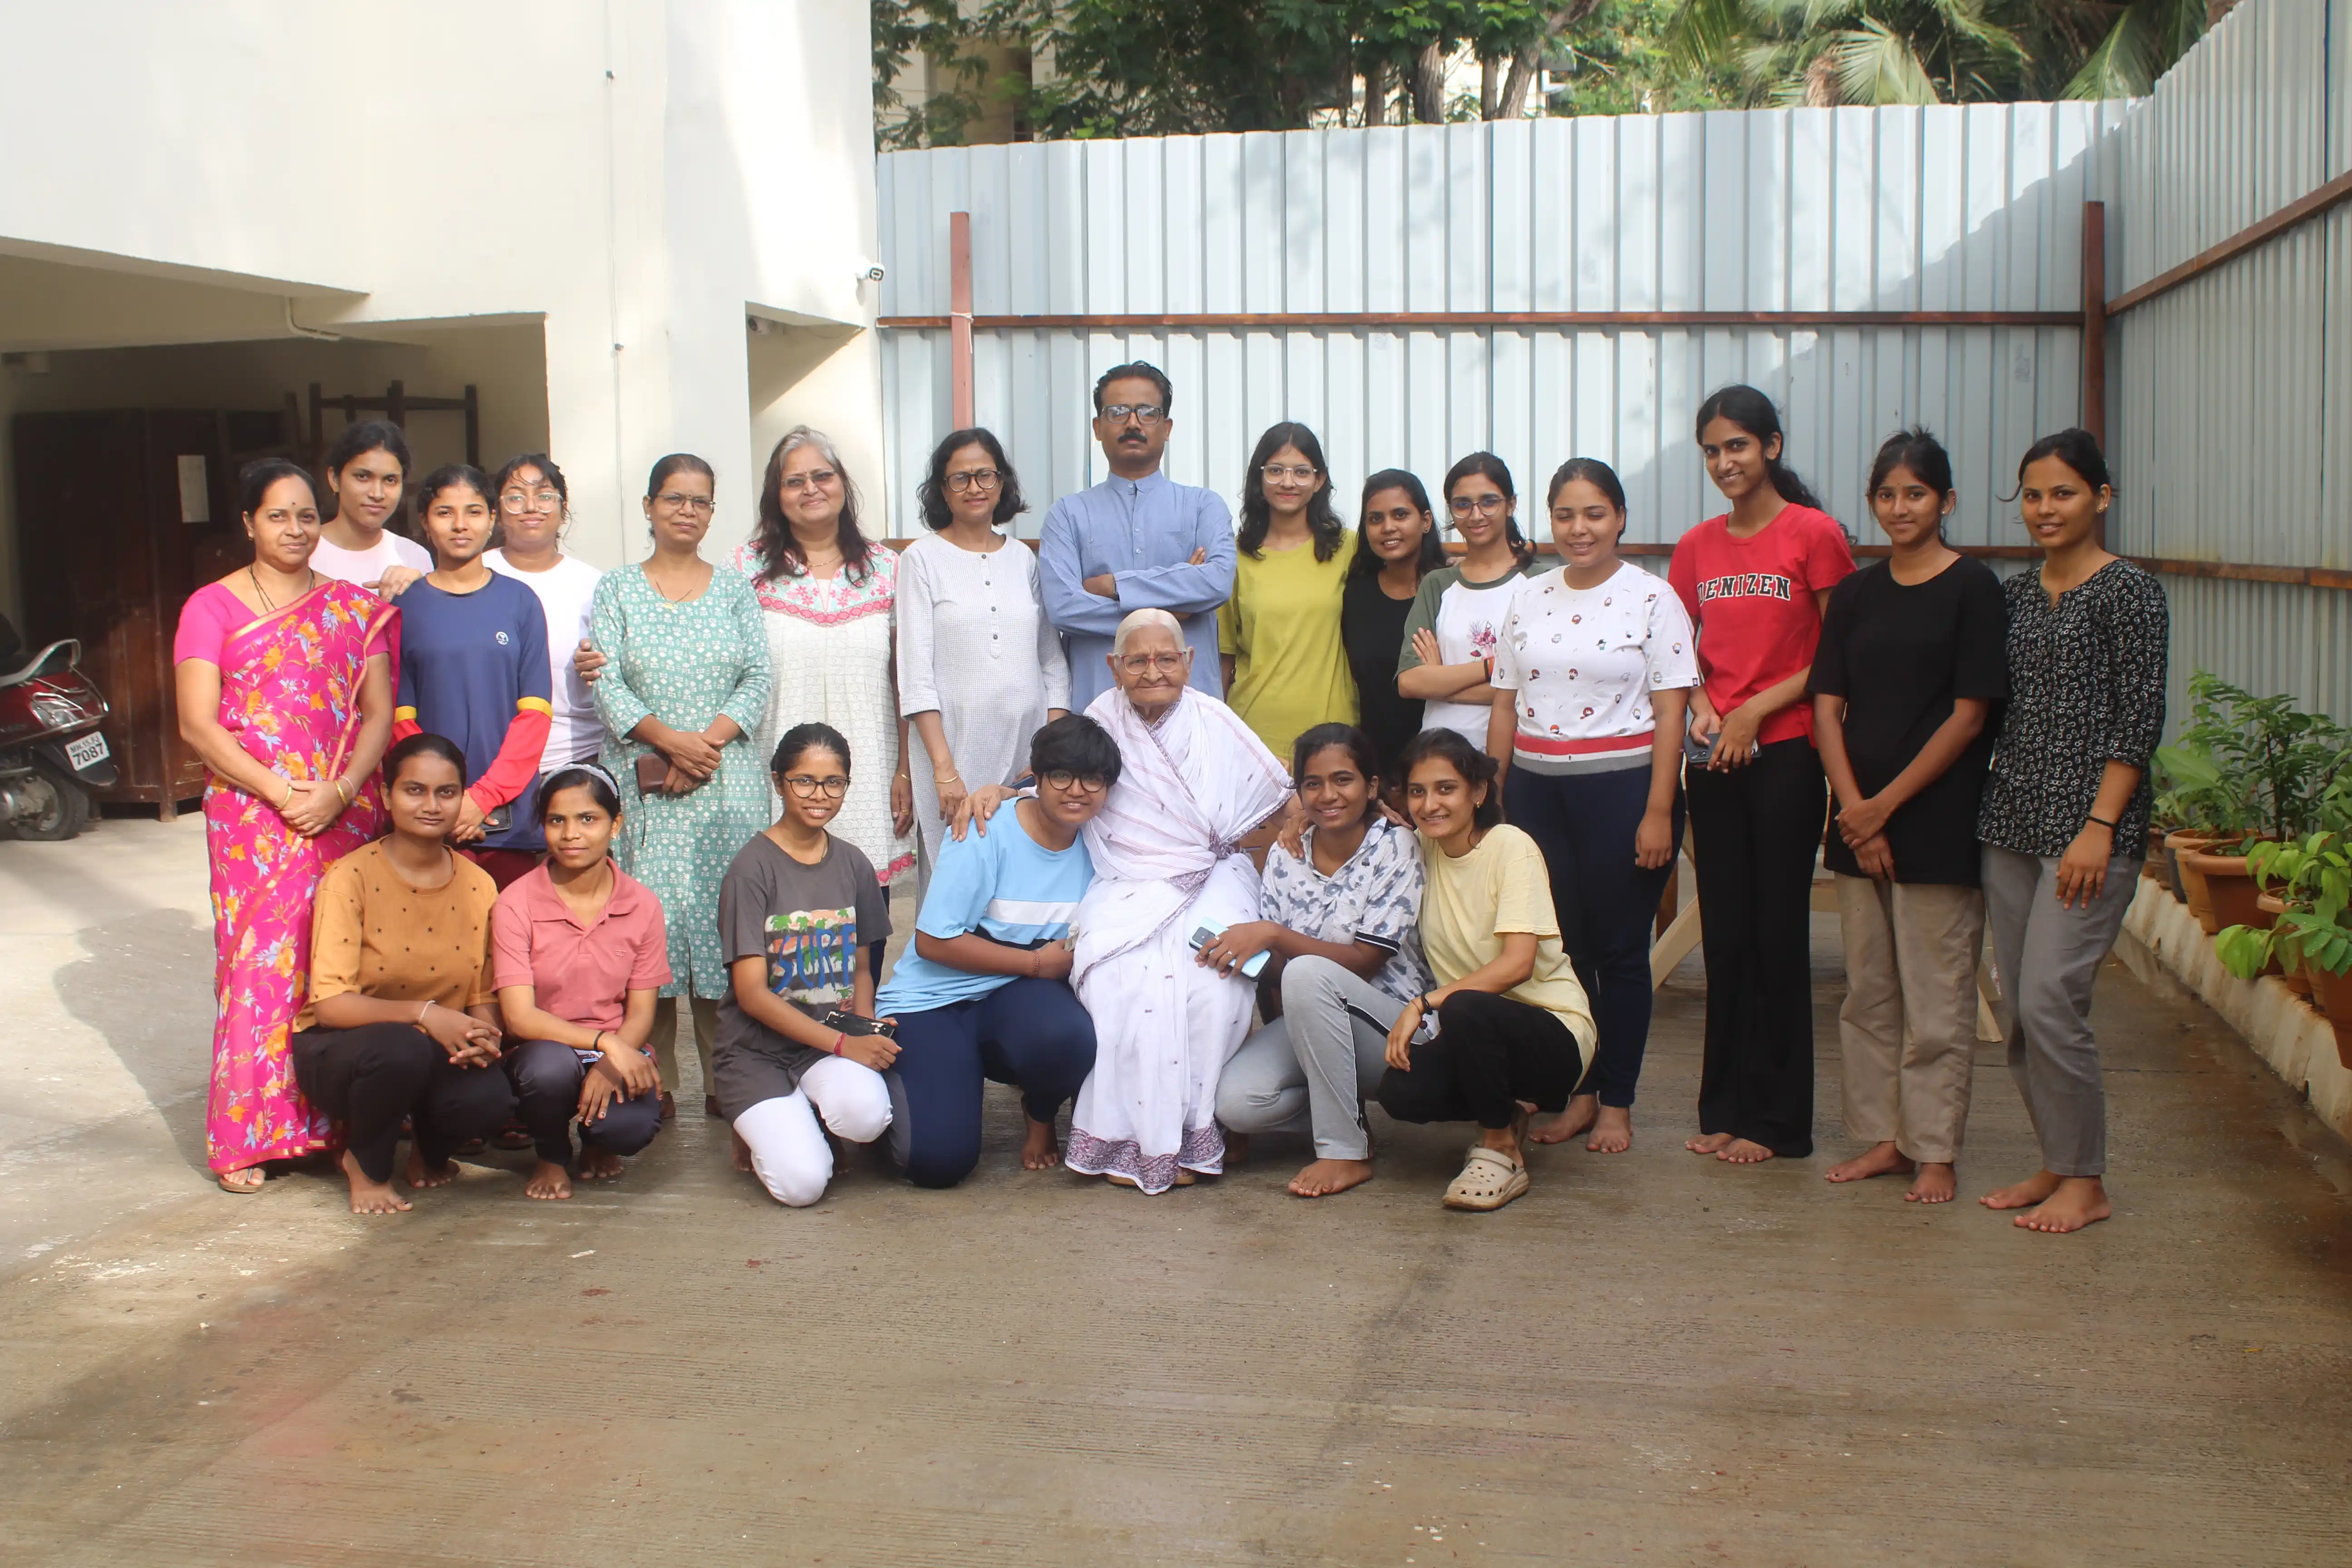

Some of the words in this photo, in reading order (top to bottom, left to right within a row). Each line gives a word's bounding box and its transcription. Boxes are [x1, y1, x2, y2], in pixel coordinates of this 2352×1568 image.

[1697, 573, 1791, 607] DENIZEN
[72, 743, 103, 765] 7087
[772, 923, 857, 995] SURF
